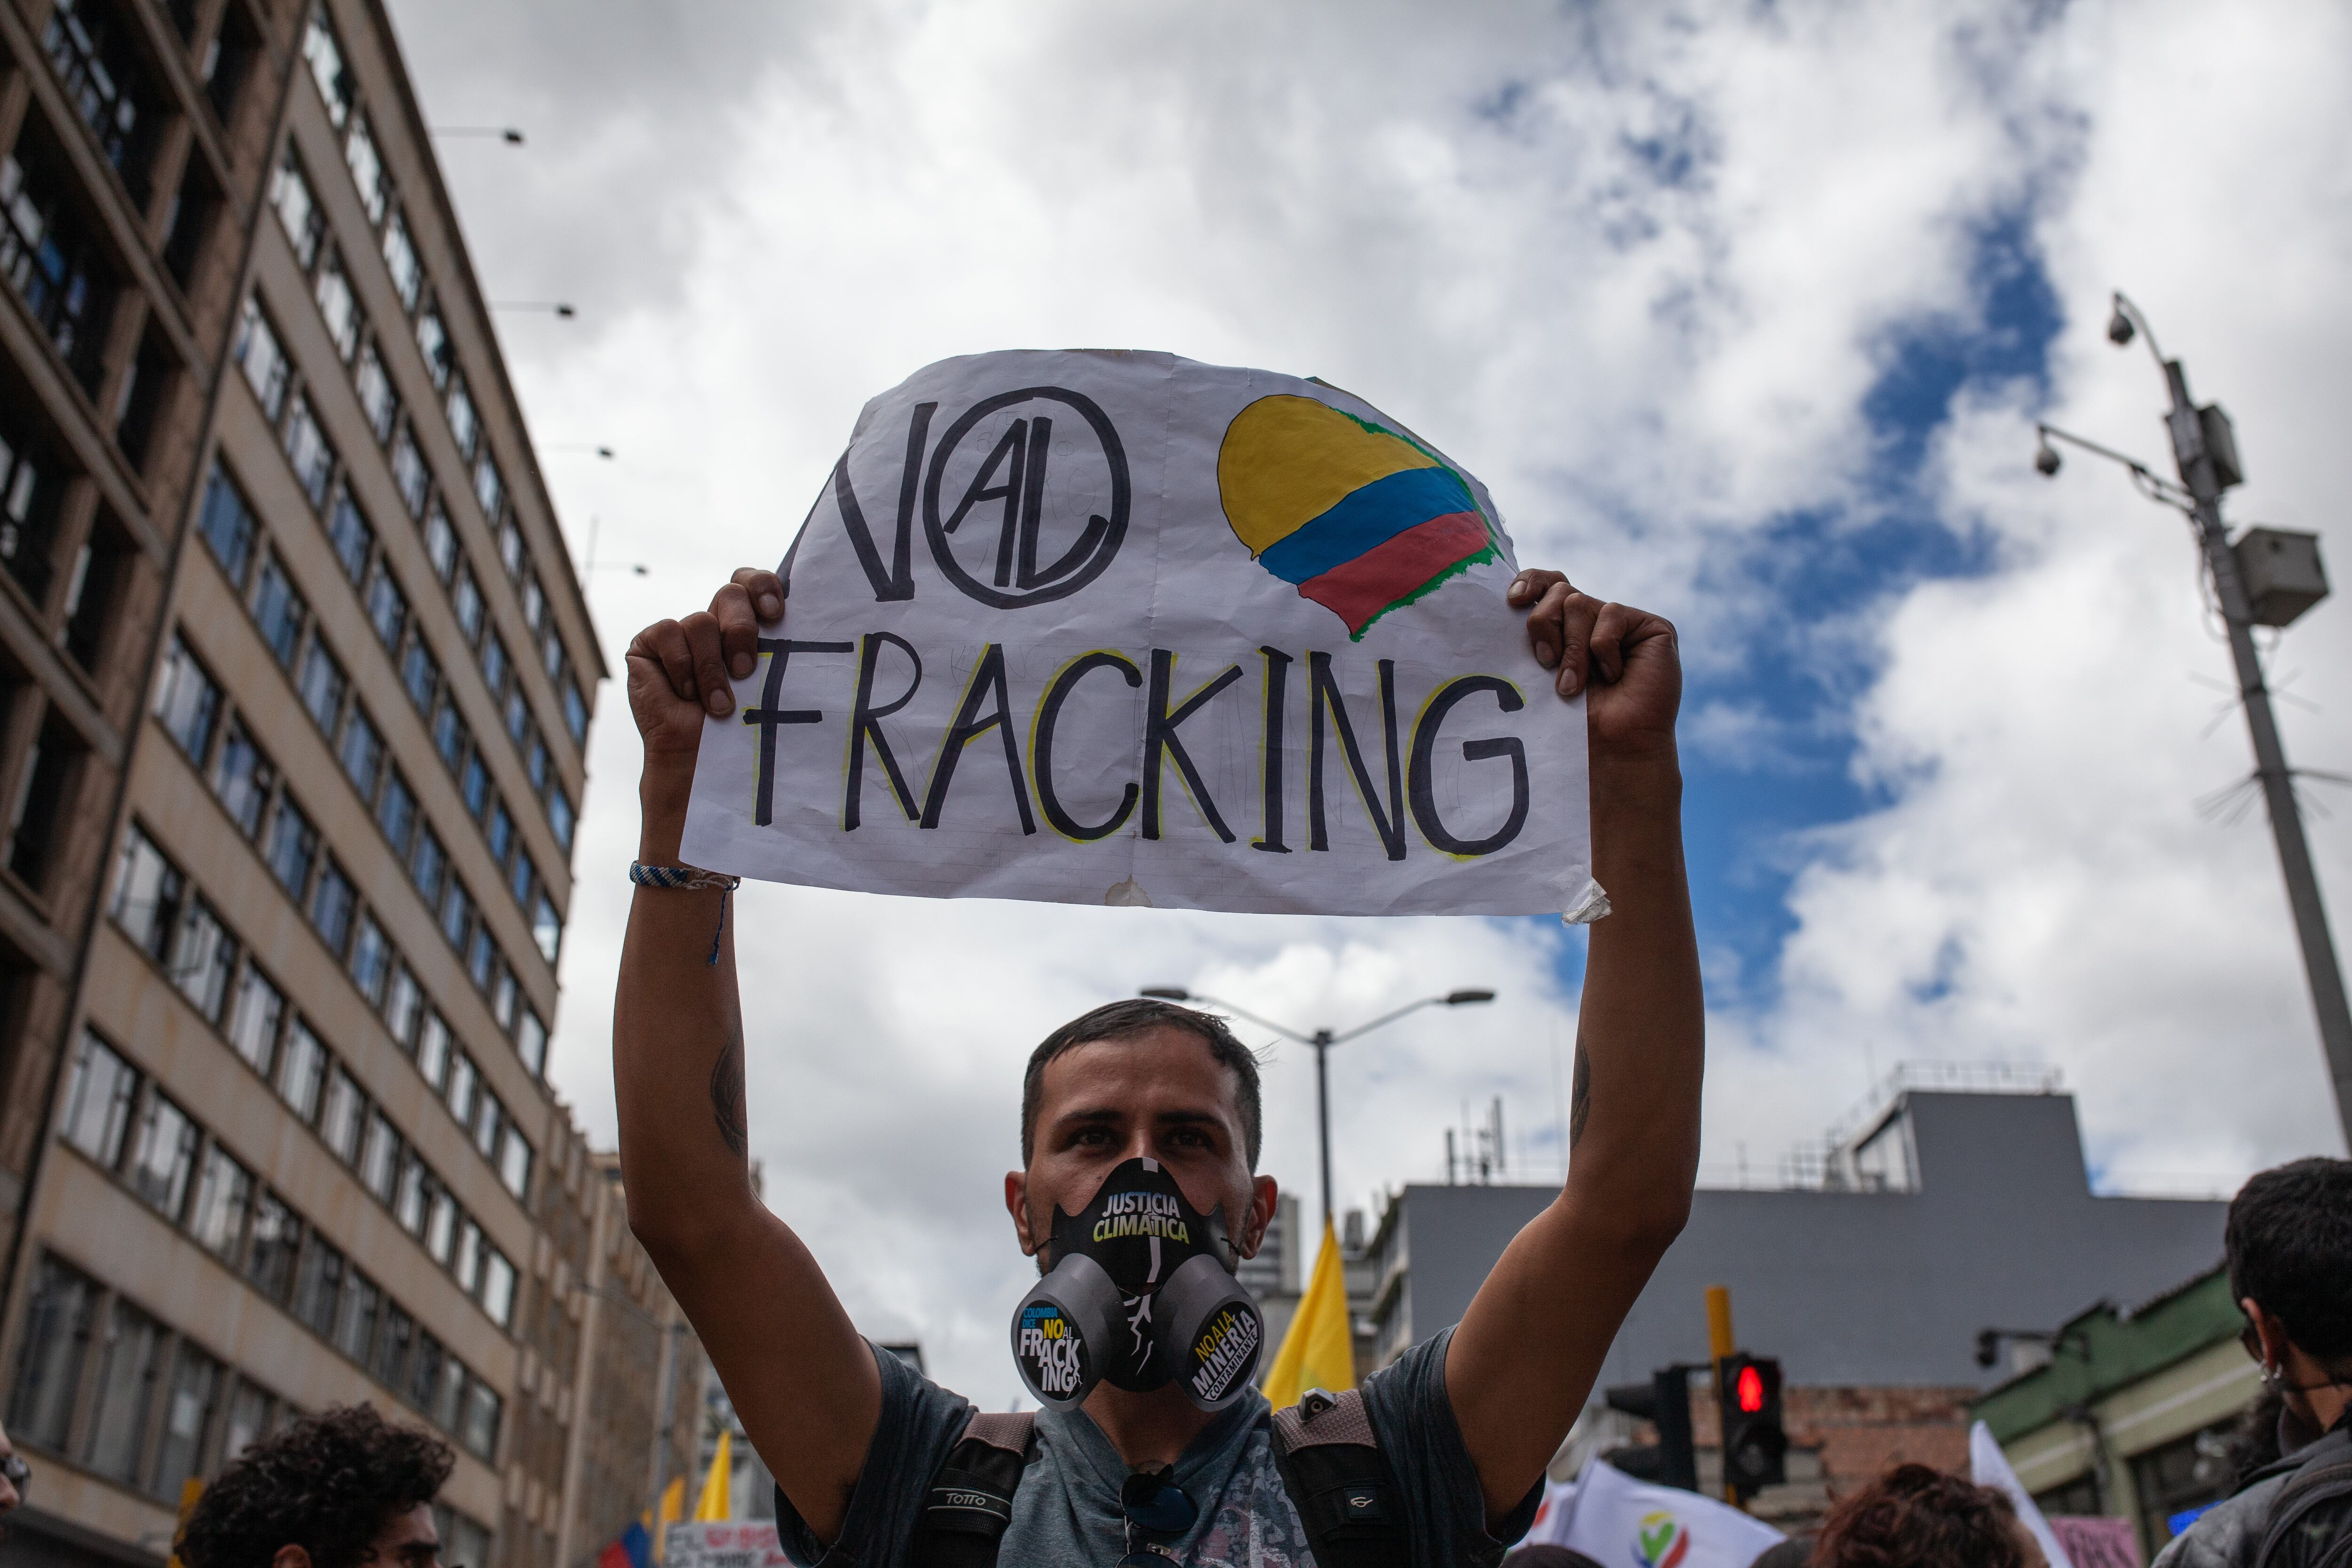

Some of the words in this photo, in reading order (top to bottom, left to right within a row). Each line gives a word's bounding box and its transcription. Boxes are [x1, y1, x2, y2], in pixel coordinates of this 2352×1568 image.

[778, 386, 1131, 610] NO
[944, 416, 1109, 591] AL
[742, 631, 1530, 861] FRACKING
[1102, 1191, 1181, 1218] JUSTICIA
[1023, 1307, 1058, 1318] COLOMBIA
[1217, 1310, 1235, 1333] LA
[1022, 1319, 1036, 1328] DICE
[1043, 1319, 1065, 1339] NO
[1062, 1326, 1074, 1339] AL
[1211, 1325, 1224, 1344] A
[1192, 1310, 1256, 1396] MINERÍA
[1195, 1335, 1216, 1363] NO
[1209, 1331, 1258, 1399] CONTAMINANTE
[946, 1493, 986, 1506] TOTTO
